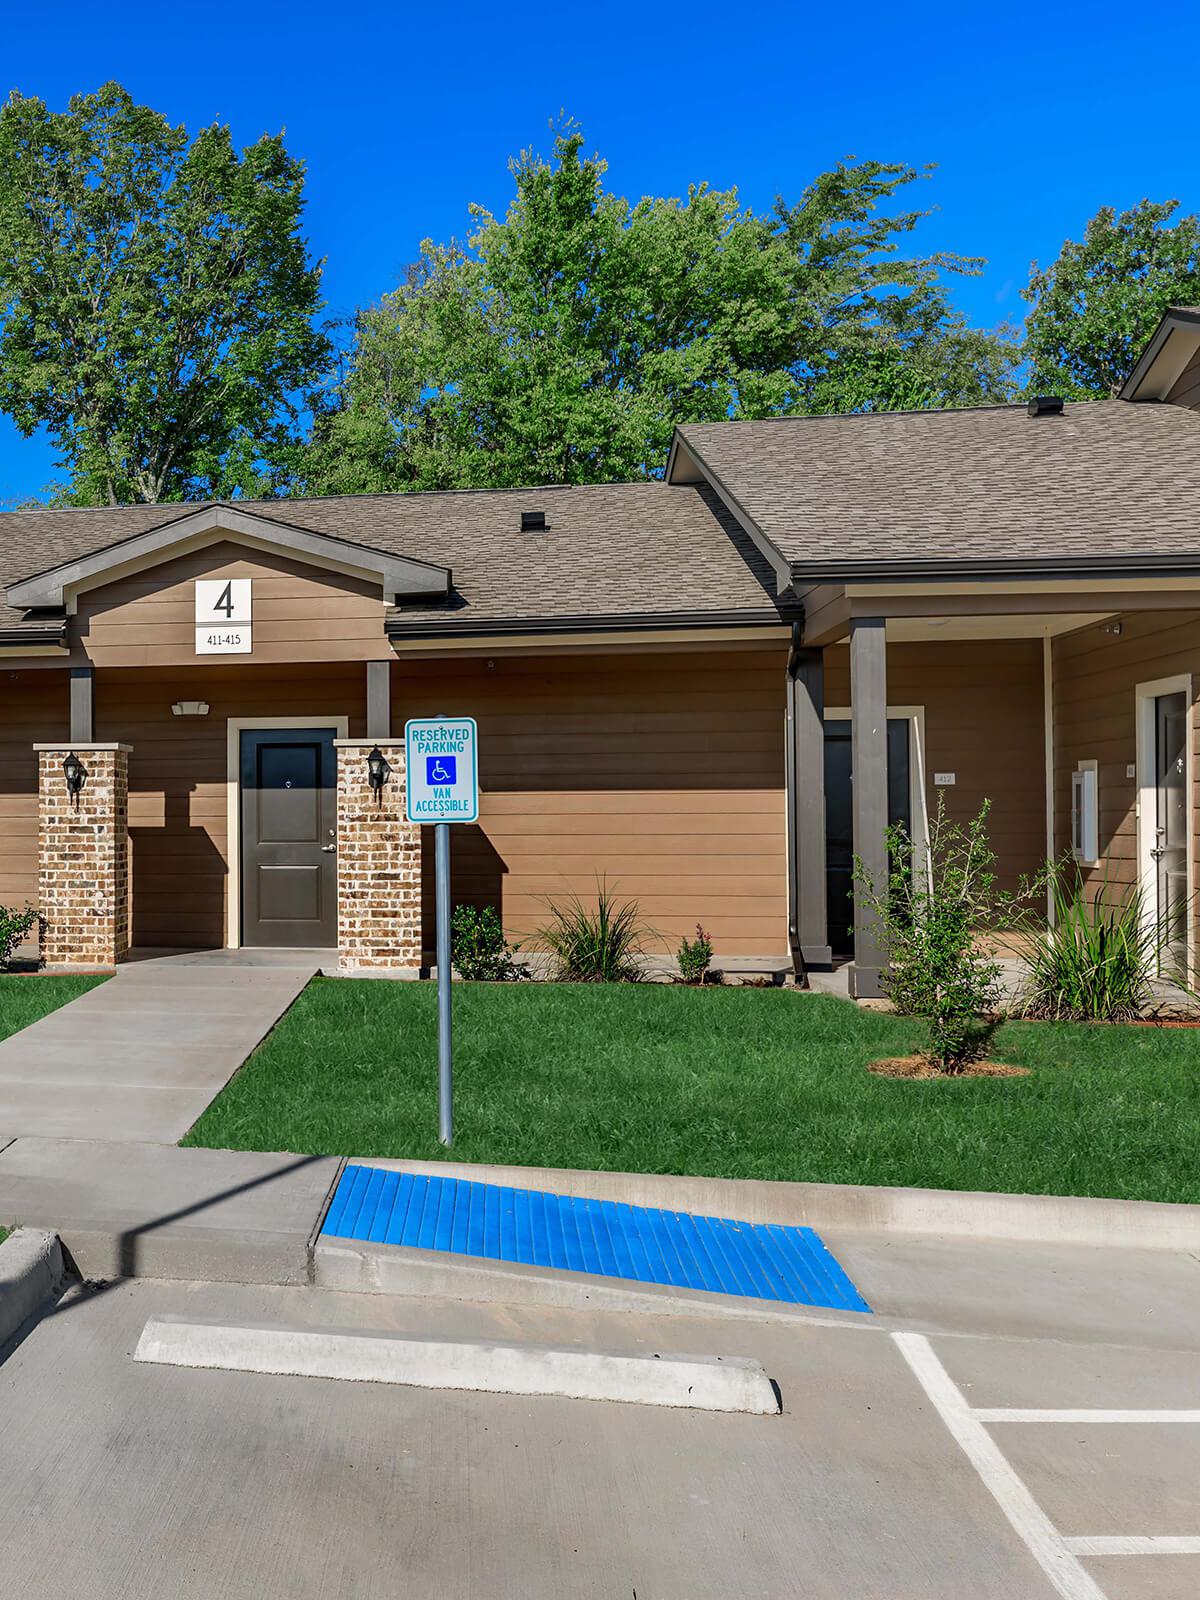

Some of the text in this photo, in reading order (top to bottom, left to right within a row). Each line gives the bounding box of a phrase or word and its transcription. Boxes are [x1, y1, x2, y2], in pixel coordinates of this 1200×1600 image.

[213, 580, 234, 618] 4
[207, 634, 241, 645] 411-415
[412, 728, 469, 741] RESERVED
[418, 741, 464, 753] PARKING
[433, 787, 451, 799] VAN
[416, 799, 469, 812] ACCESSIBLE
